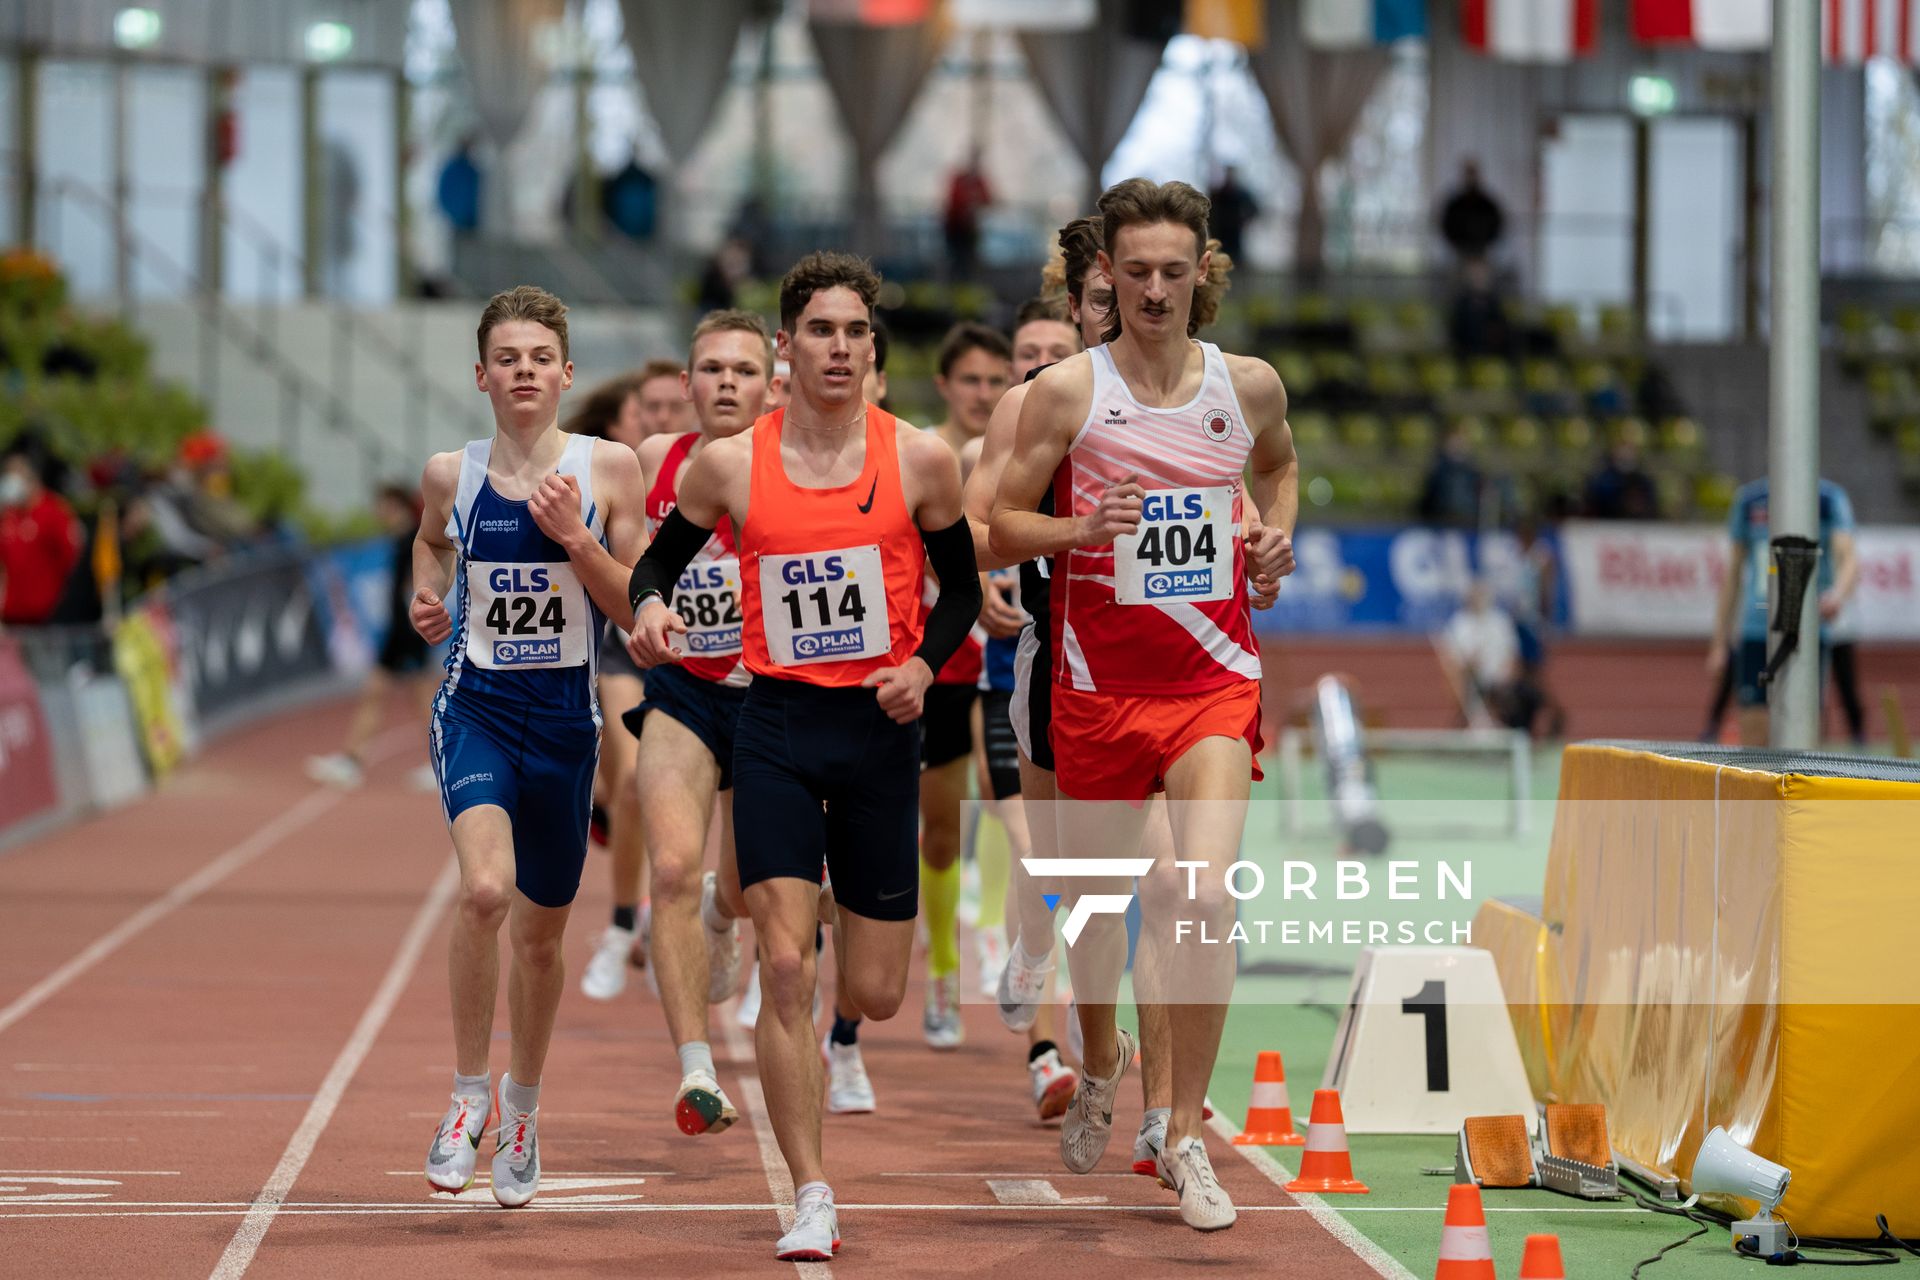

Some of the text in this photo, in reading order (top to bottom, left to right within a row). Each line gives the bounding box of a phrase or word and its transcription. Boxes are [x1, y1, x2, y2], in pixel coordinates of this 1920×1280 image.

[480, 518, 518, 528] panzeri
[1137, 524, 1216, 566] 404
[1174, 574, 1209, 587] PLAN
[676, 591, 743, 627] 682
[782, 584, 866, 629] 114
[486, 597, 566, 635] 424
[707, 631, 741, 645] PLAN
[821, 633, 861, 648] PLAN
[520, 643, 558, 655] PLAN
[823, 645, 862, 653] INTERNATIONAL
[1401, 980, 1449, 1092] 1
